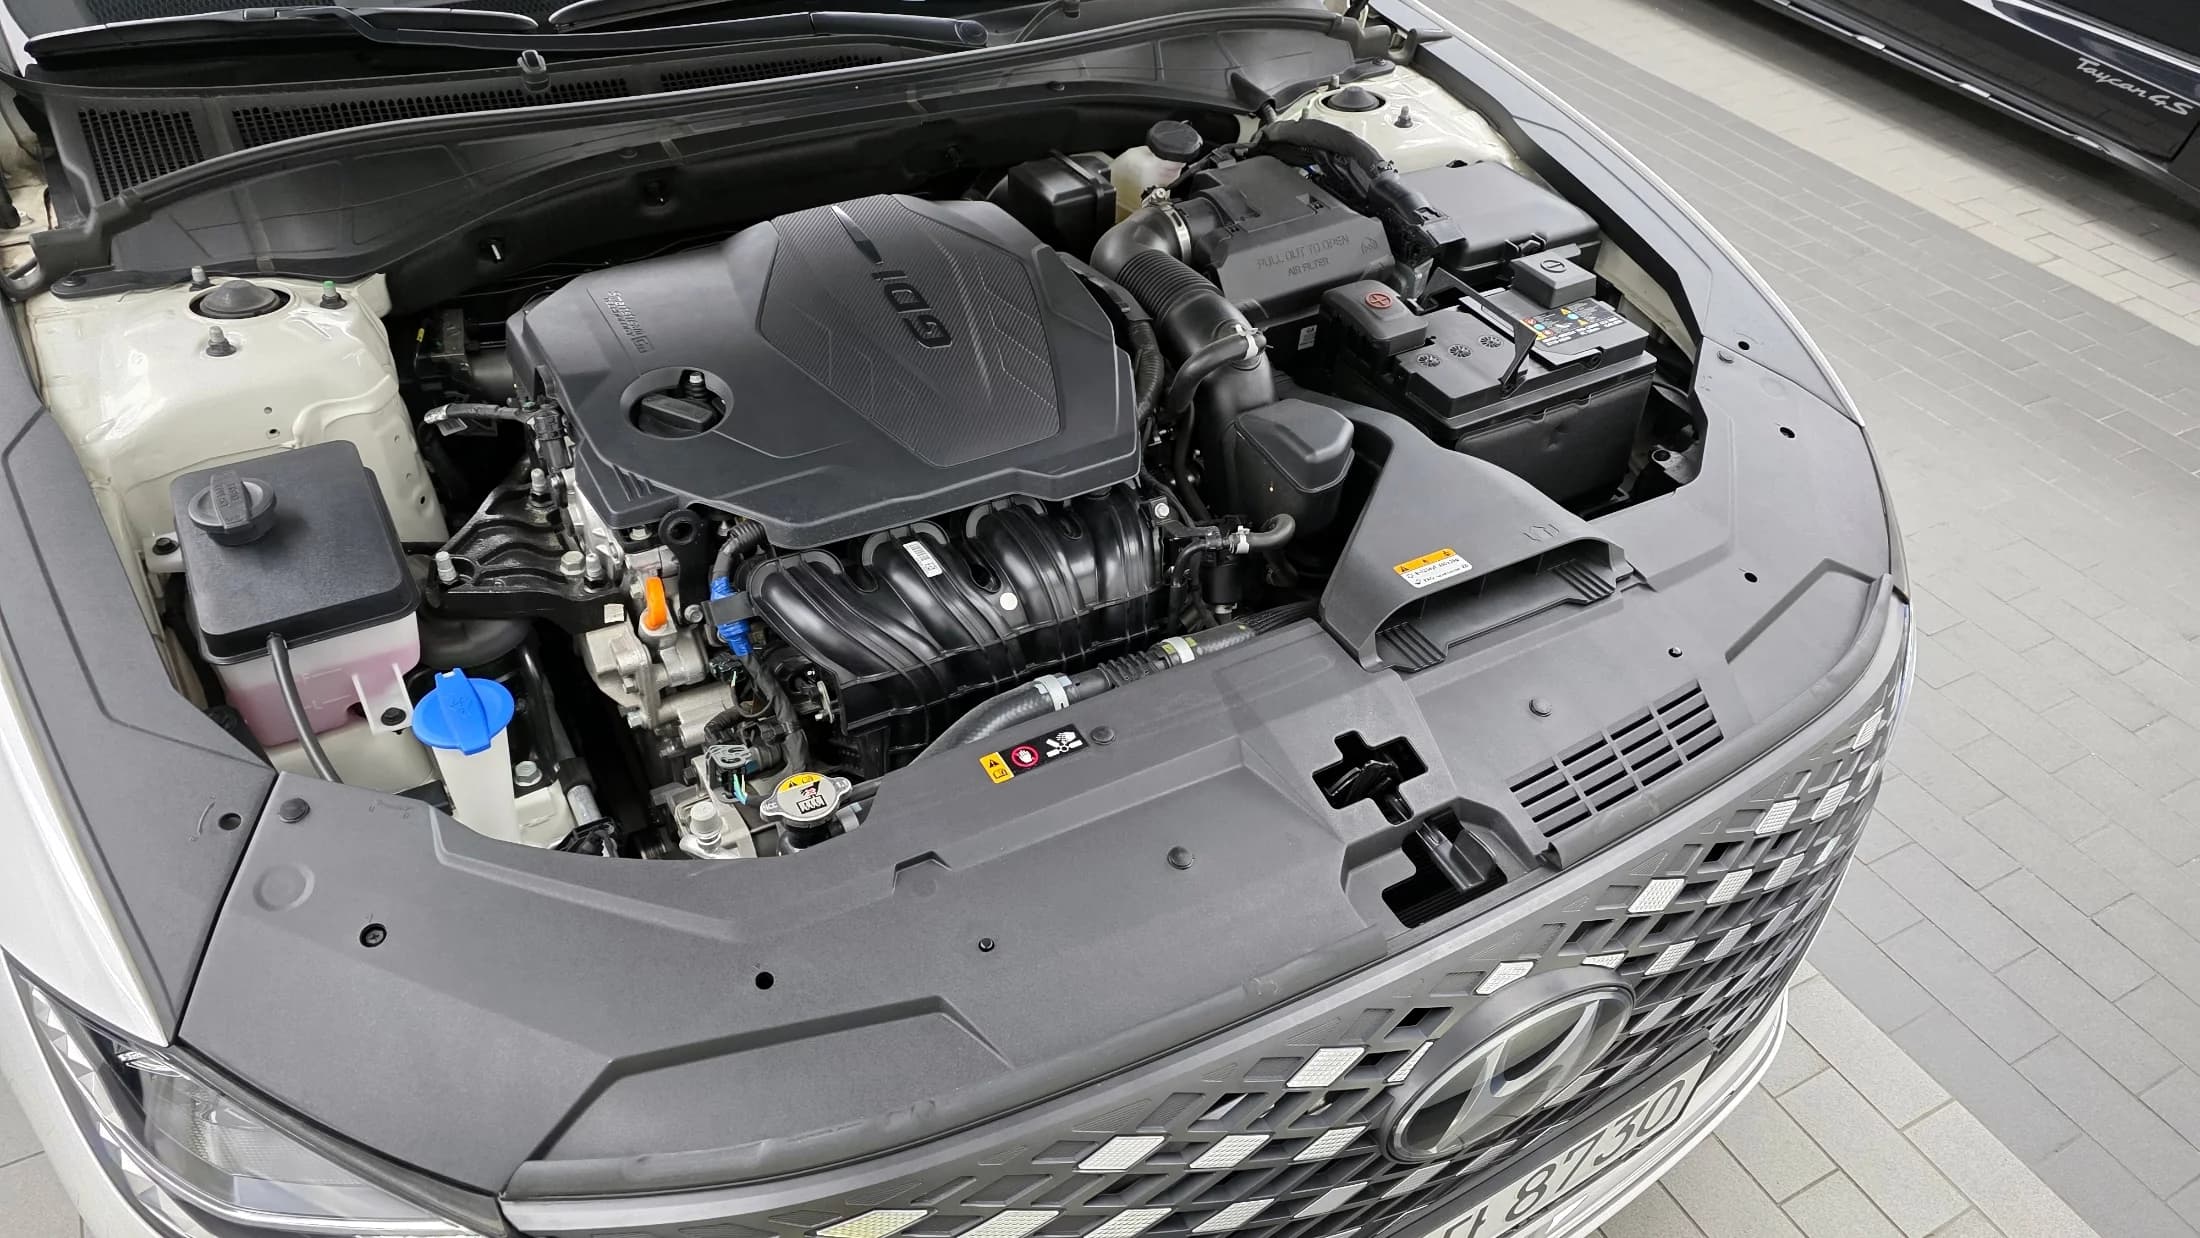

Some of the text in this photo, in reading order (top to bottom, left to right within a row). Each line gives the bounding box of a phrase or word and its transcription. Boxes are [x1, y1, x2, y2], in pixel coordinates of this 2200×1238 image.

[2077, 57, 2194, 116] Taycan 4S
[1285, 246, 1305, 260] OUT
[1308, 242, 1321, 256] TO
[1322, 233, 1350, 249] OPEN
[1288, 257, 1330, 276] AIR FILTER
[872, 270, 953, 349] GDI
[1505, 1079, 1686, 1222] 8730
